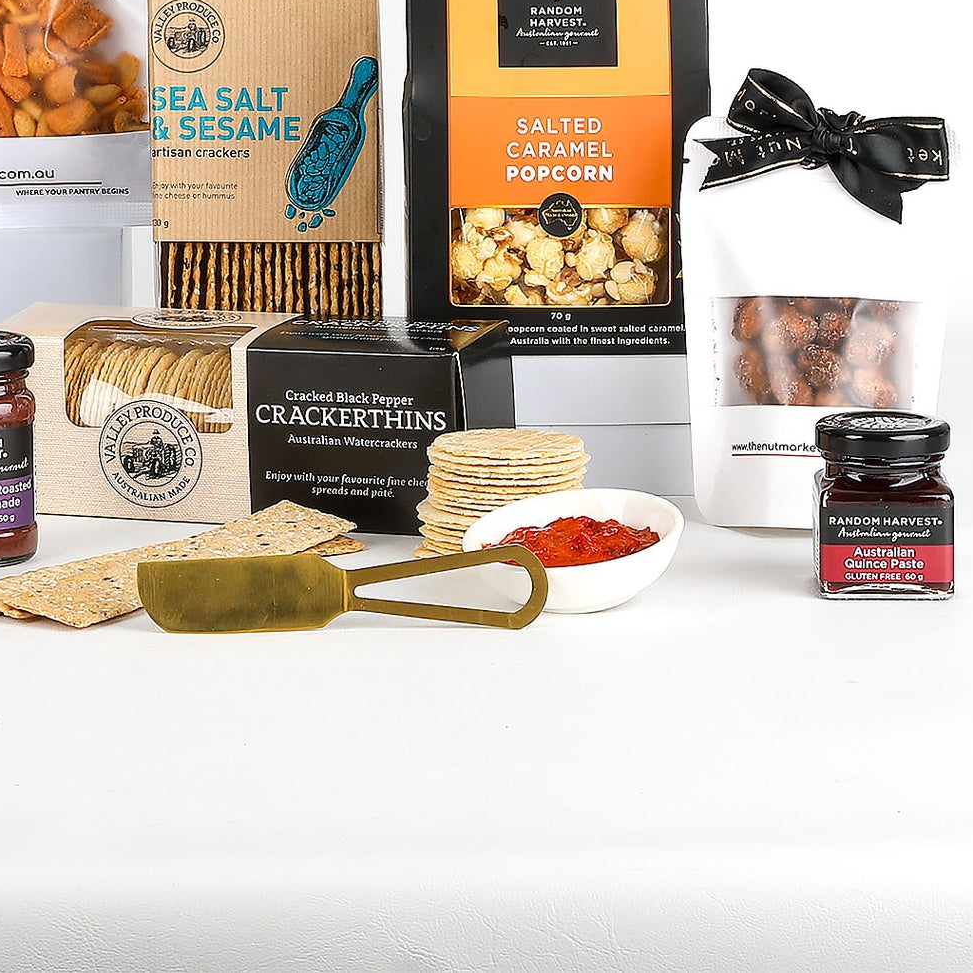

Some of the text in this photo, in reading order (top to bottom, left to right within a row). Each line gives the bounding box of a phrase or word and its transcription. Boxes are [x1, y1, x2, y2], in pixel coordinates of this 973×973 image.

[530, 6, 583, 16] RANDOM
[153, 5, 176, 44] VALLEY
[176, 1, 220, 29] PRODUCE
[515, 27, 564, 39] Australian
[152, 86, 288, 112] SEA SALT
[152, 116, 301, 141] & SESAME
[516, 117, 602, 135] SALTED
[151, 146, 250, 158] artisan crackers
[506, 141, 613, 158] CARAMEL
[506, 165, 613, 182] POPCORN
[45, 188, 68, 196] YOUR
[101, 187, 129, 195] BEGINS
[170, 181, 186, 190] with
[187, 182, 204, 191] your
[205, 181, 238, 190] favourite
[550, 312, 572, 321] 70 g
[547, 325, 578, 333] coated
[580, 324, 589, 333] in
[590, 325, 617, 333] sweet
[619, 324, 646, 333] salted
[509, 336, 671, 347] Australia with the finest ingredients.
[285, 389, 414, 408] Cracked Black Pepper
[255, 404, 447, 431] CRACKERTHINS
[104, 409, 133, 464] VALLEY
[133, 405, 194, 445] PRODUCE
[287, 433, 418, 450] Australian Watercrackers
[731, 440, 820, 453] www.thenutmarke
[265, 470, 406, 487] Enjoy with your favourite fine
[112, 471, 191, 502] AUSTRALIAN MADE
[311, 485, 349, 496] spreads
[350, 486, 369, 497] and
[9, 514, 15, 523] g
[828, 516, 880, 526] RANDOM
[838, 526, 932, 543] Australian gourmet
[853, 546, 915, 558] Australian
[844, 558, 925, 570] Quince Paste
[844, 572, 878, 581] GLUTEN
[904, 572, 915, 581] 60
[917, 573, 924, 581] g
